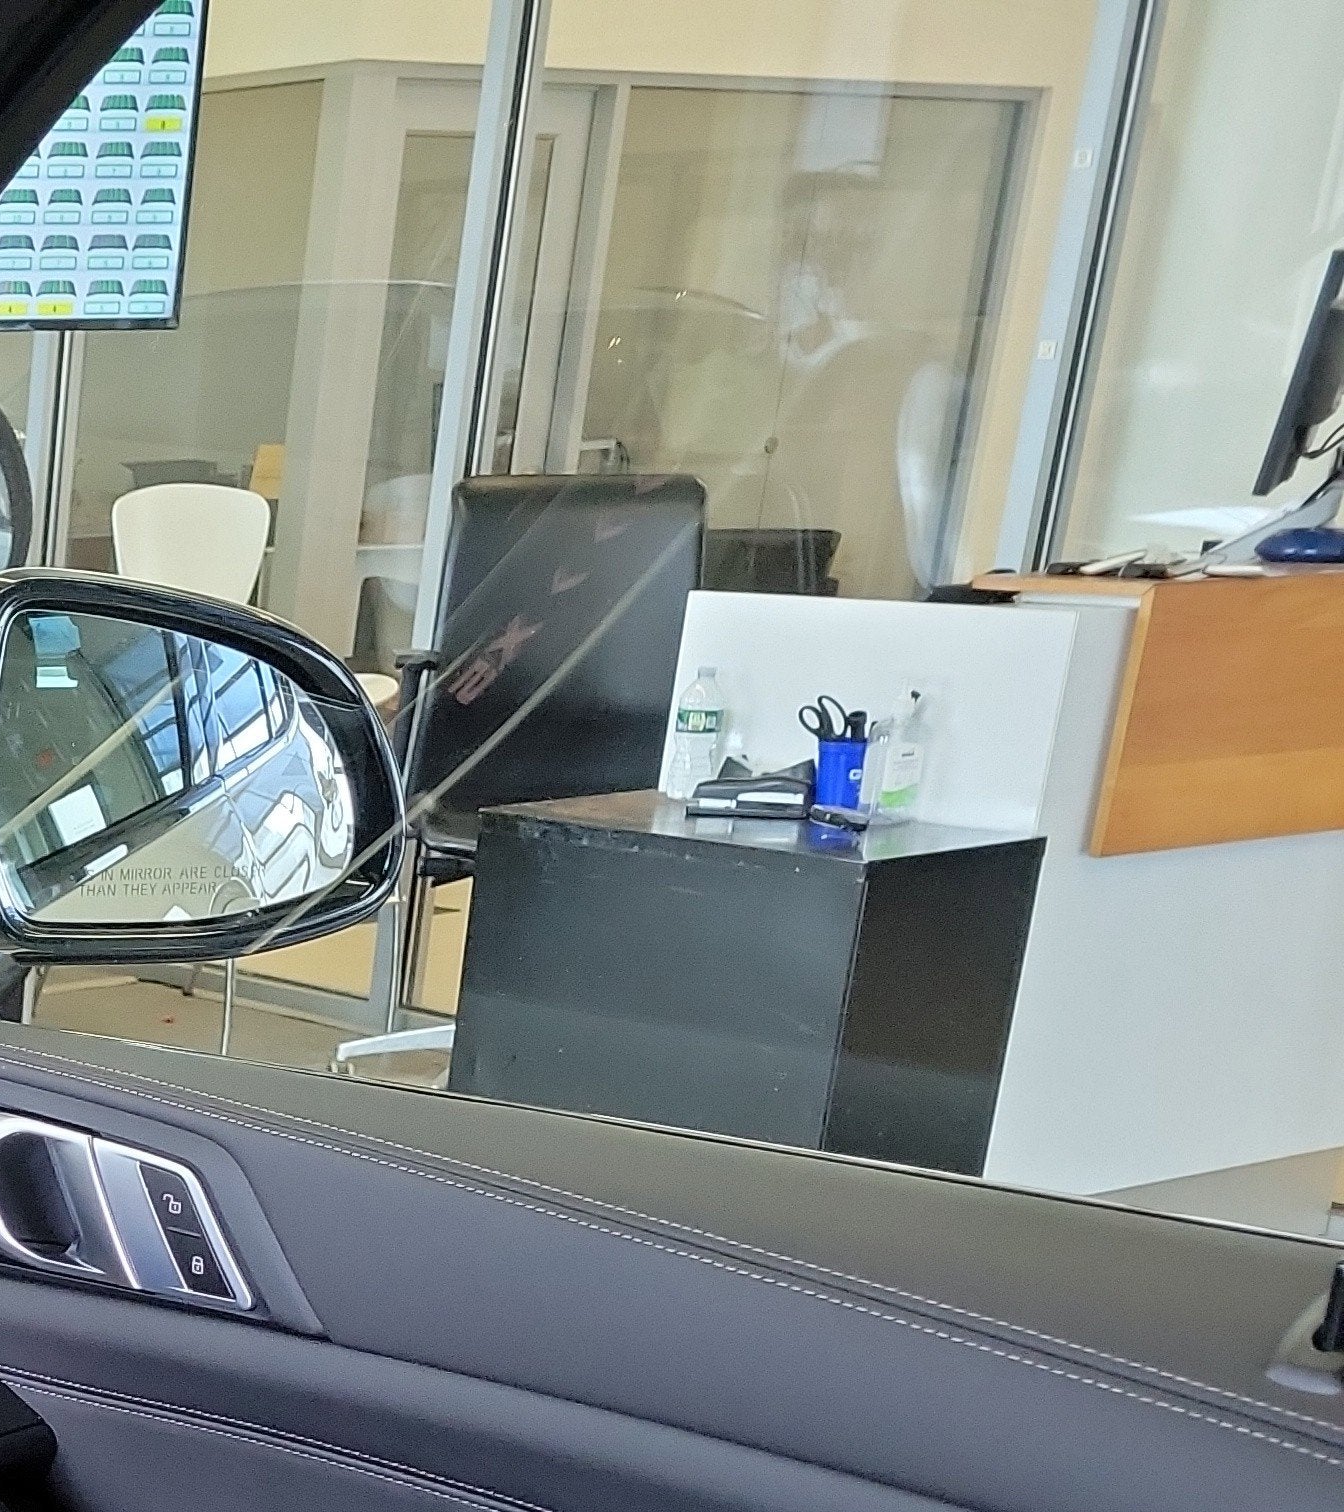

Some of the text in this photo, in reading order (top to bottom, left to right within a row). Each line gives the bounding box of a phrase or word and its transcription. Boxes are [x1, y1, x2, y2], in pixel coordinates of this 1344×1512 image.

[101, 869, 114, 881] IN
[119, 866, 172, 881] MIRROR
[179, 865, 208, 880] ARE
[79, 881, 217, 898] THAN THEY APPEAR
